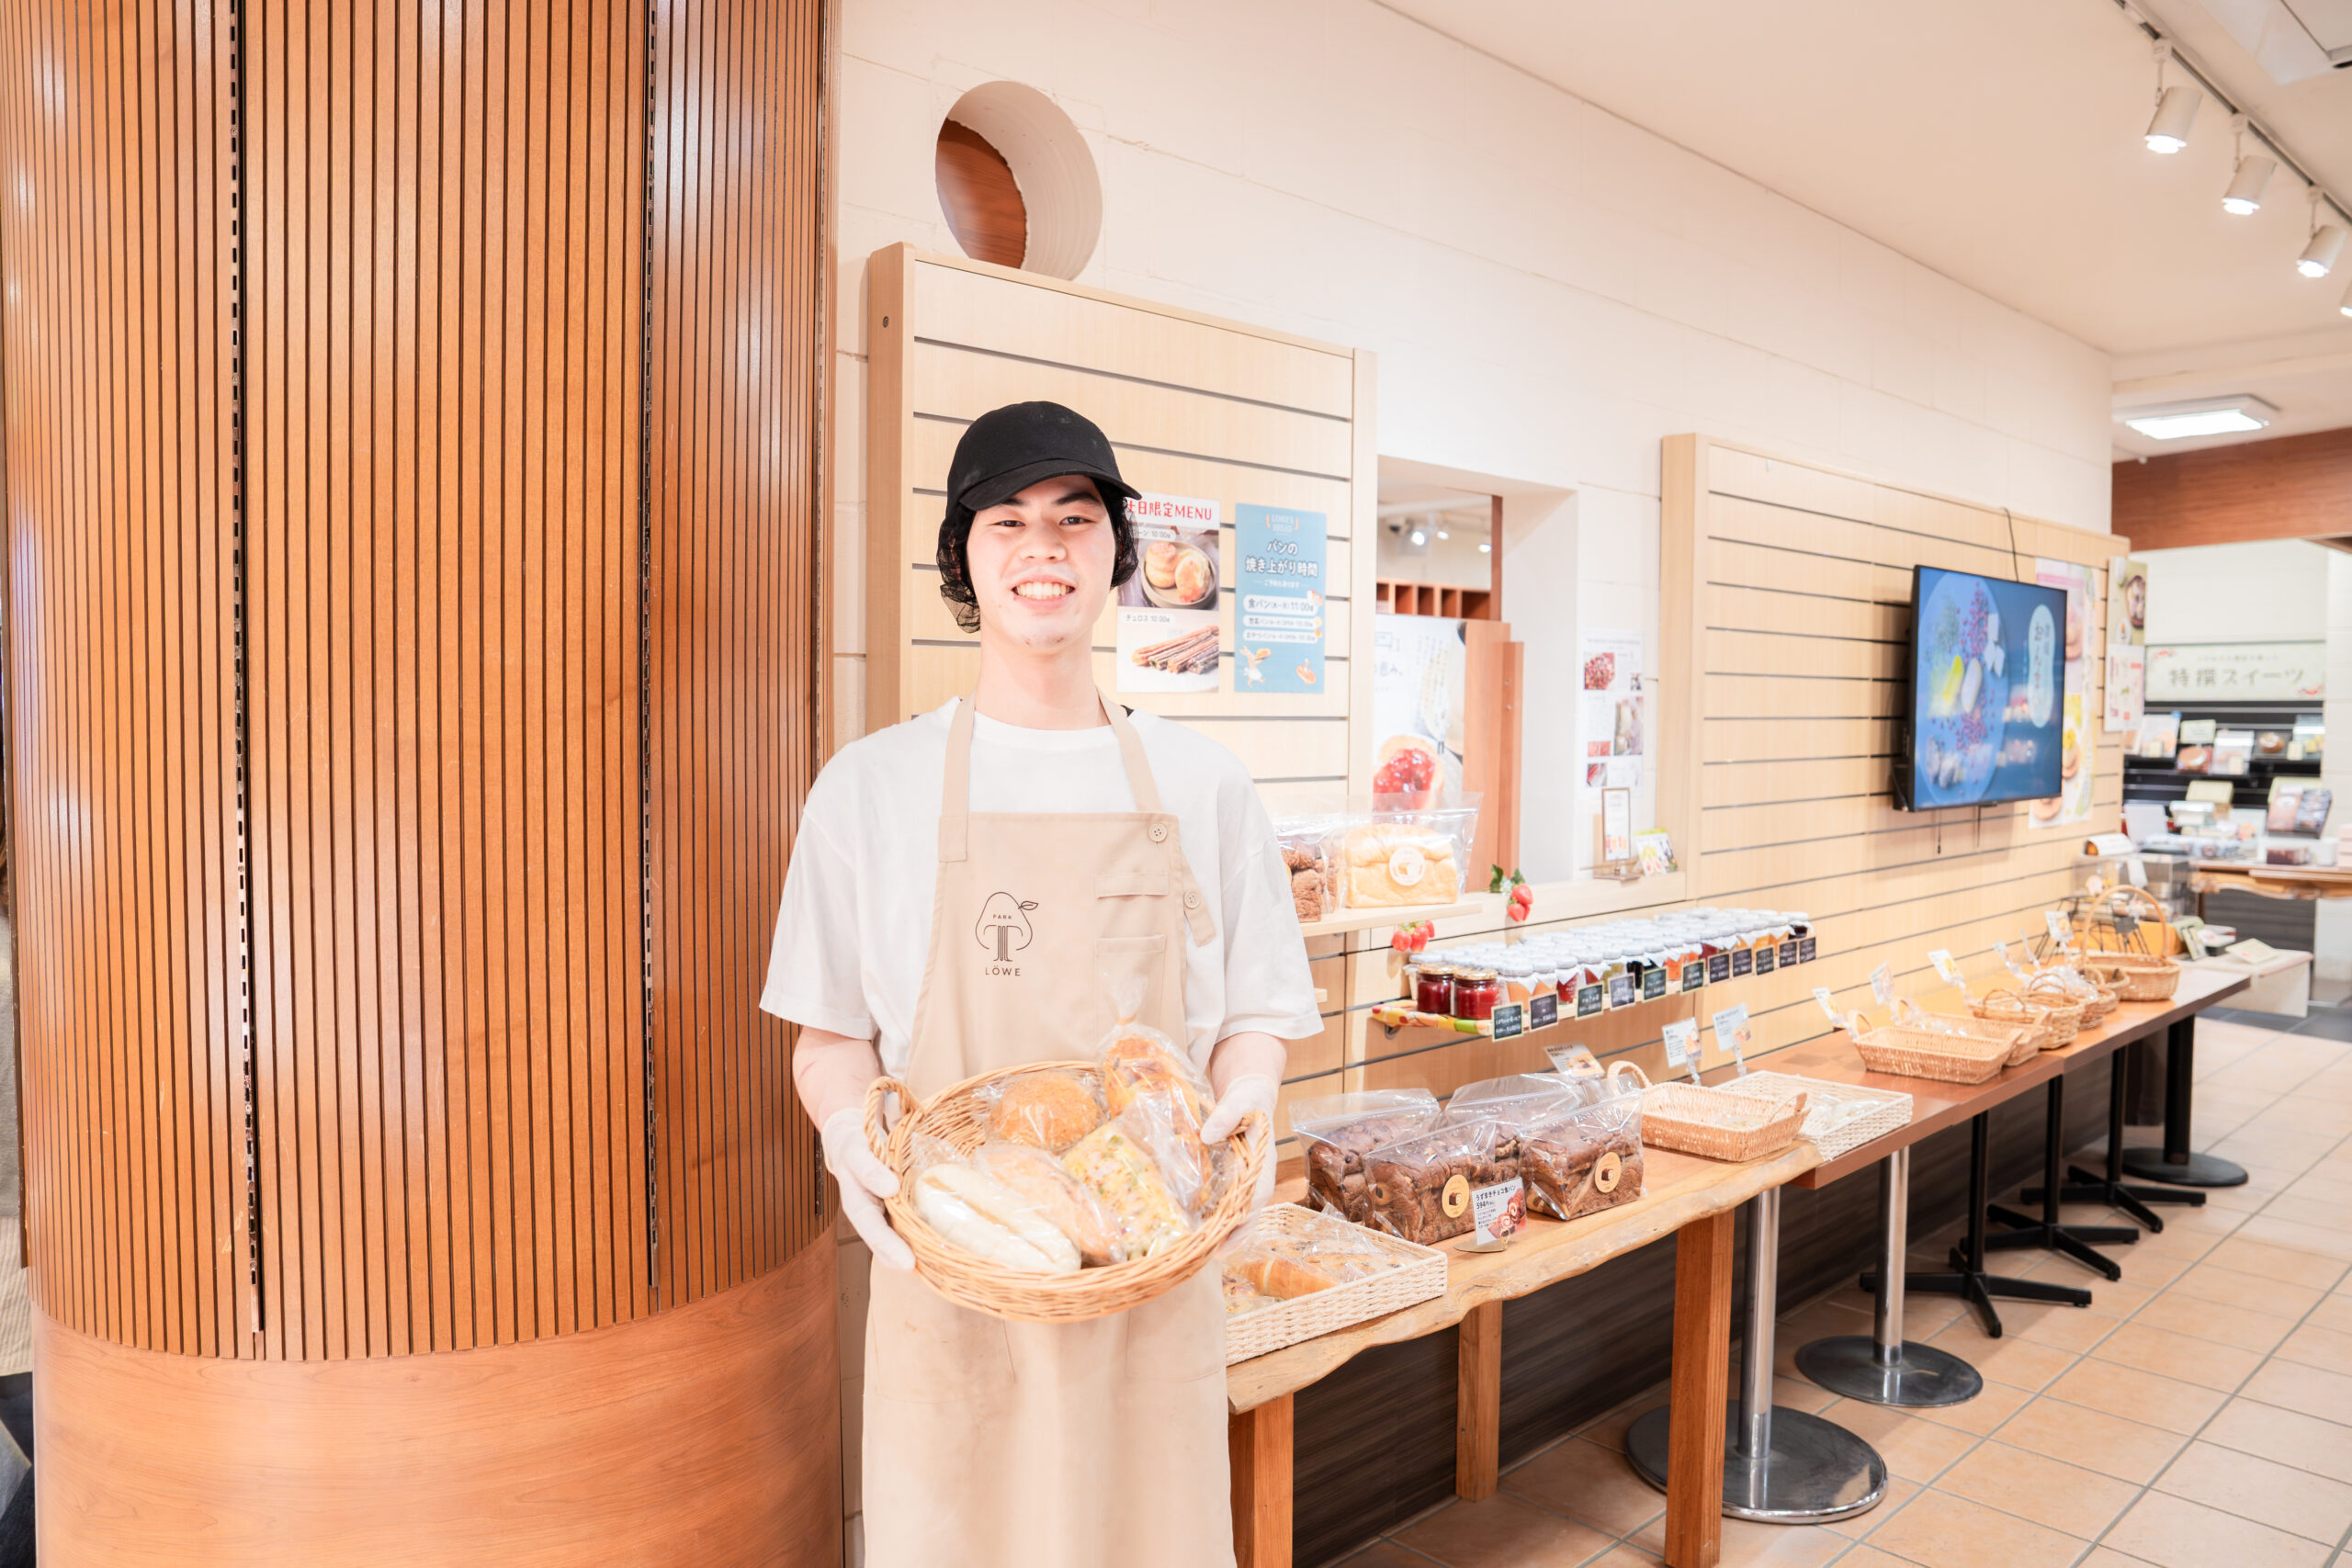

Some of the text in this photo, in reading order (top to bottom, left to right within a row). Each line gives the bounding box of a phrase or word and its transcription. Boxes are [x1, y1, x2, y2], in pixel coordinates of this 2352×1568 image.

[1266, 539, 1298, 555] パンの
[1245, 556, 1317, 577] 焼き上がり時間
[985, 964, 1021, 976] LÖWE
